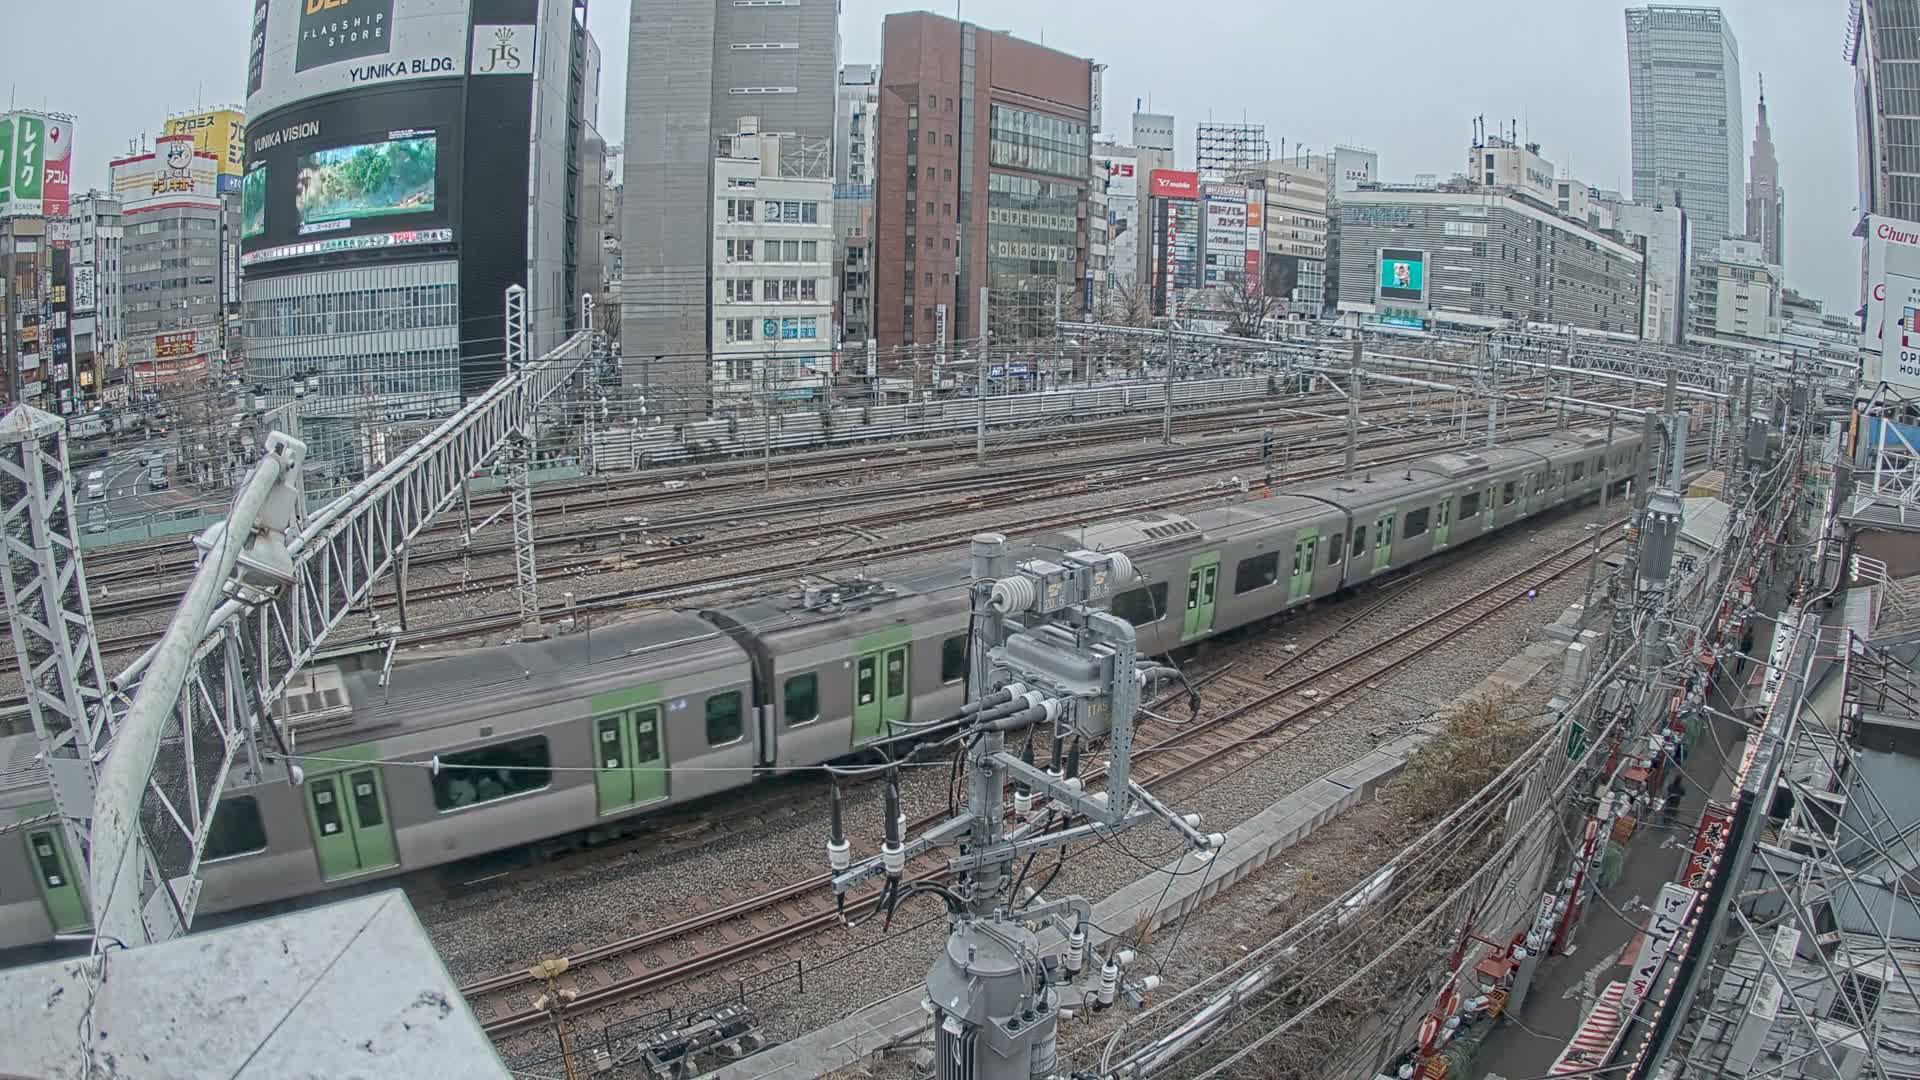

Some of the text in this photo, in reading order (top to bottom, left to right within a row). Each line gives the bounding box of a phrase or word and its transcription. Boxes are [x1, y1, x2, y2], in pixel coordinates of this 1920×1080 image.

[304, 13, 383, 40] FLAGSHIP
[328, 27, 382, 47] STORE
[350, 57, 456, 82] YUNIKA BLDG.
[254, 120, 320, 153] YUNIKA VISION
[21, 120, 37, 188] レイク
[46, 168, 69, 185] アコム
